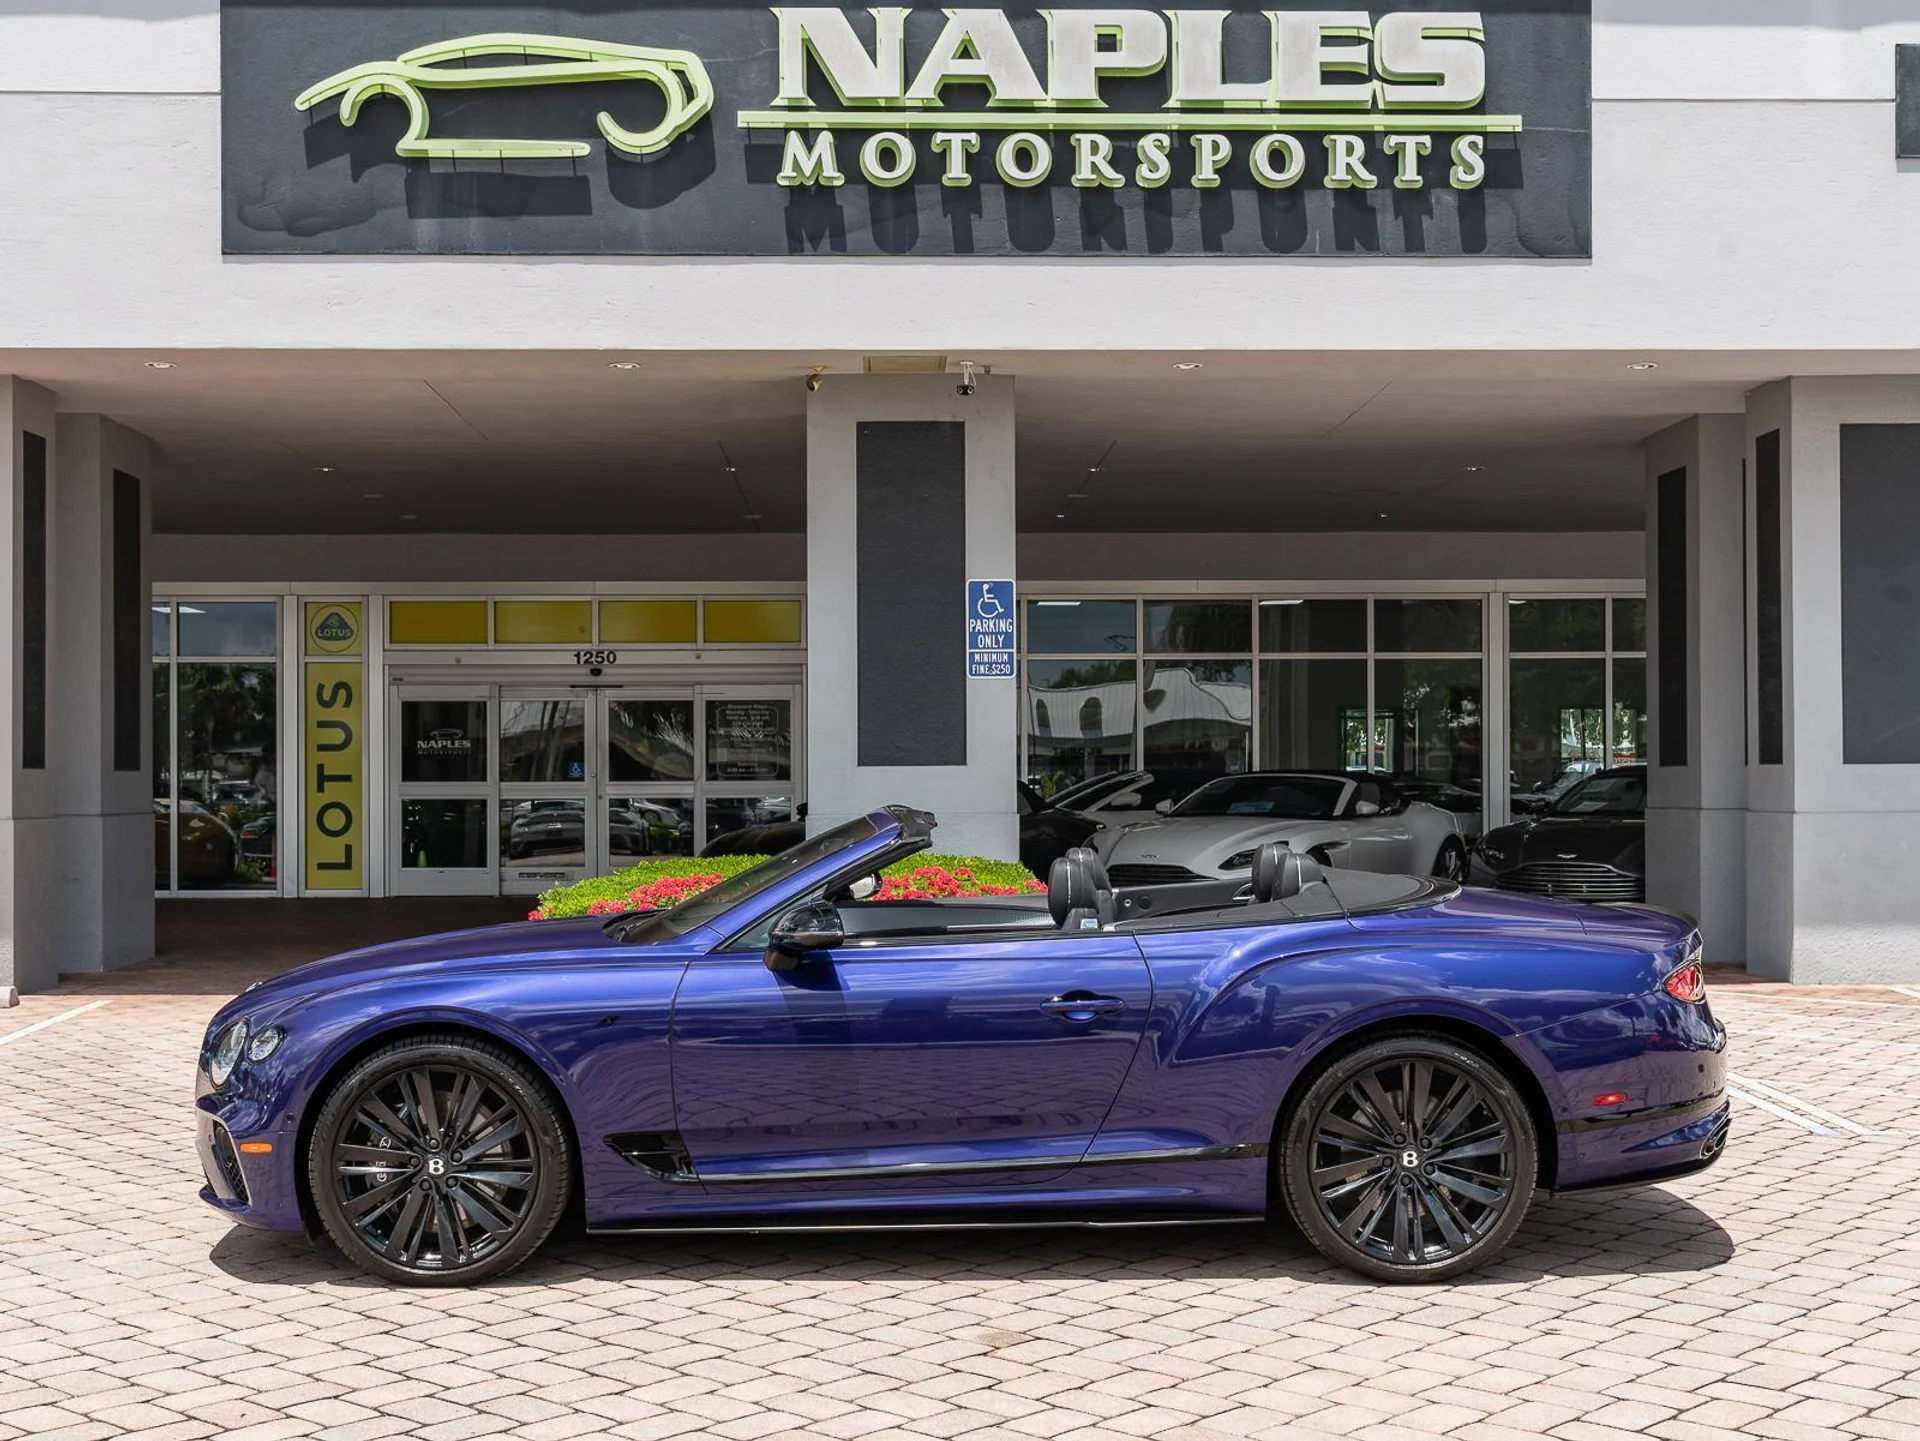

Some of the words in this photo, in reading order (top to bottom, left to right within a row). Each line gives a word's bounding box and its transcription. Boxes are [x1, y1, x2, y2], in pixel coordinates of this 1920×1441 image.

[769, 7, 1486, 110] NAPLES
[776, 130, 1485, 190] MOTORSPORTS
[317, 628, 352, 637] LOTUS
[969, 619, 1013, 633] PARKING
[977, 634, 1005, 648] ONLY
[573, 650, 617, 665] 1250
[974, 652, 1008, 663] MINIMUM
[972, 664, 989, 675] FINE
[991, 663, 1011, 675] $250
[417, 740, 471, 749] NAPLES
[316, 681, 353, 871] LOTUS
[428, 1158, 444, 1175] B
[1402, 1151, 1419, 1168] B
